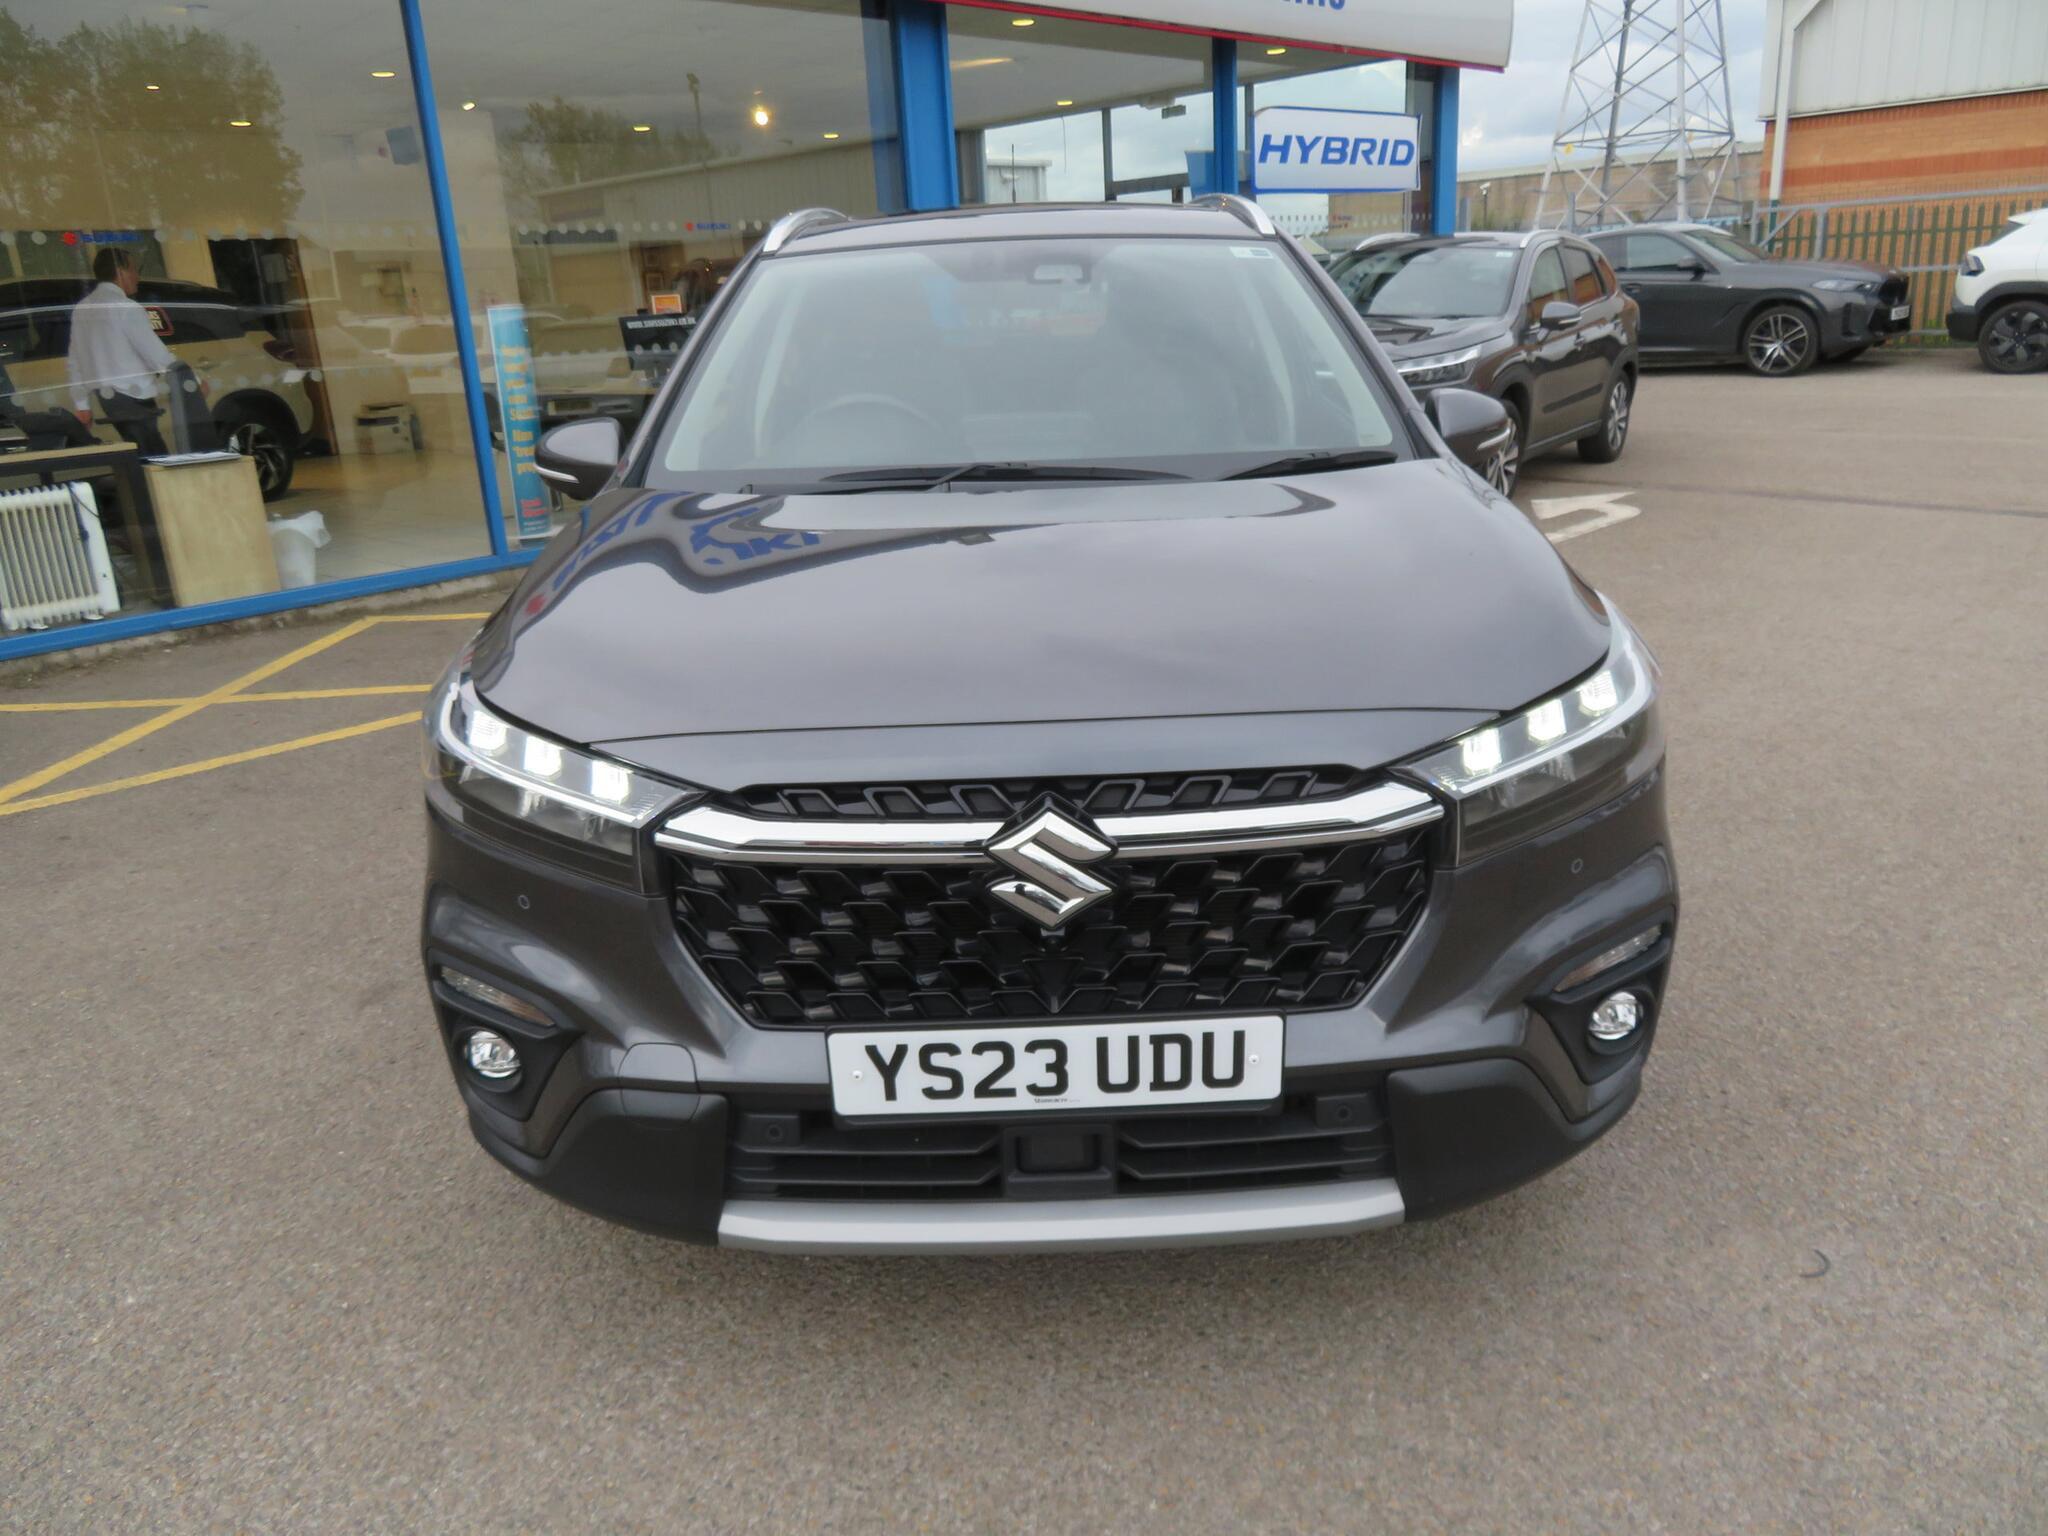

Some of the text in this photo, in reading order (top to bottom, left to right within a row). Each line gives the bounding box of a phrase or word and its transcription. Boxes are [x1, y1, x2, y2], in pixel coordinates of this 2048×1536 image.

[1258, 134, 1416, 167] HYBRID
[864, 1029, 1246, 1102] YS23 UDU
